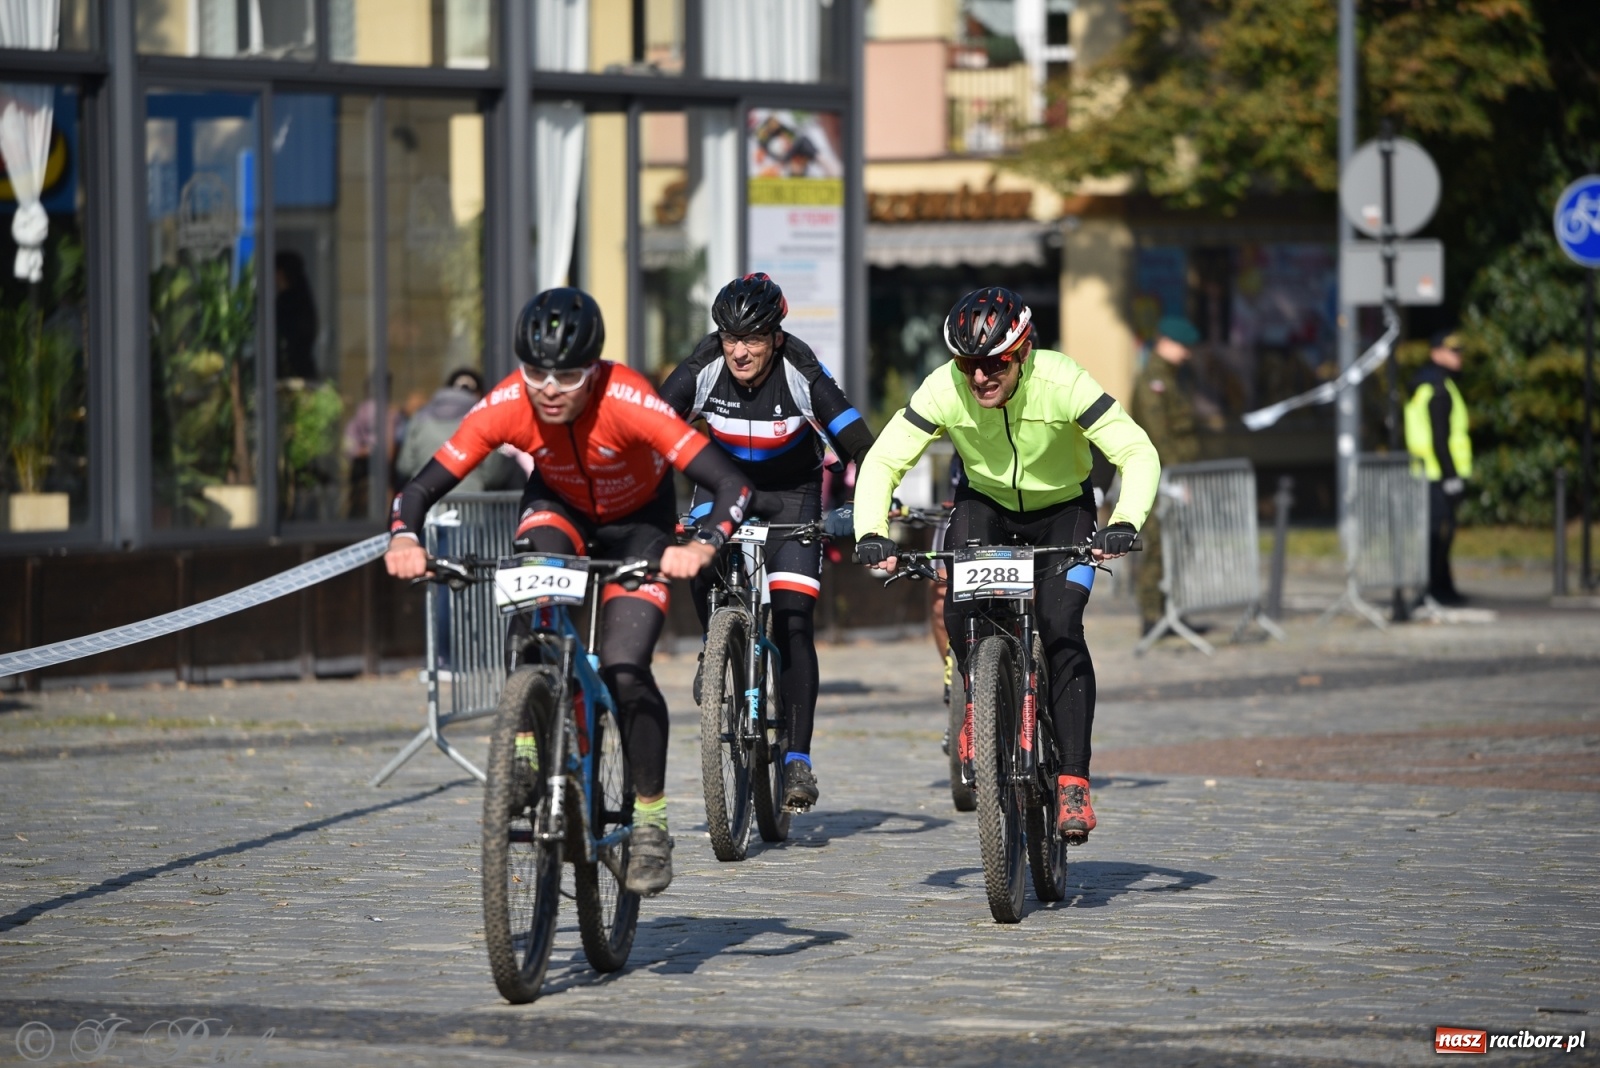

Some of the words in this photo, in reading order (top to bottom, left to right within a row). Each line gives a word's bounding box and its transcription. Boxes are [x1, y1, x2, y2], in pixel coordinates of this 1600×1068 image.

[490, 382, 520, 406] BIKE
[606, 382, 642, 406] JURA
[514, 573, 571, 593] 1240
[965, 567, 1020, 585] 2288
